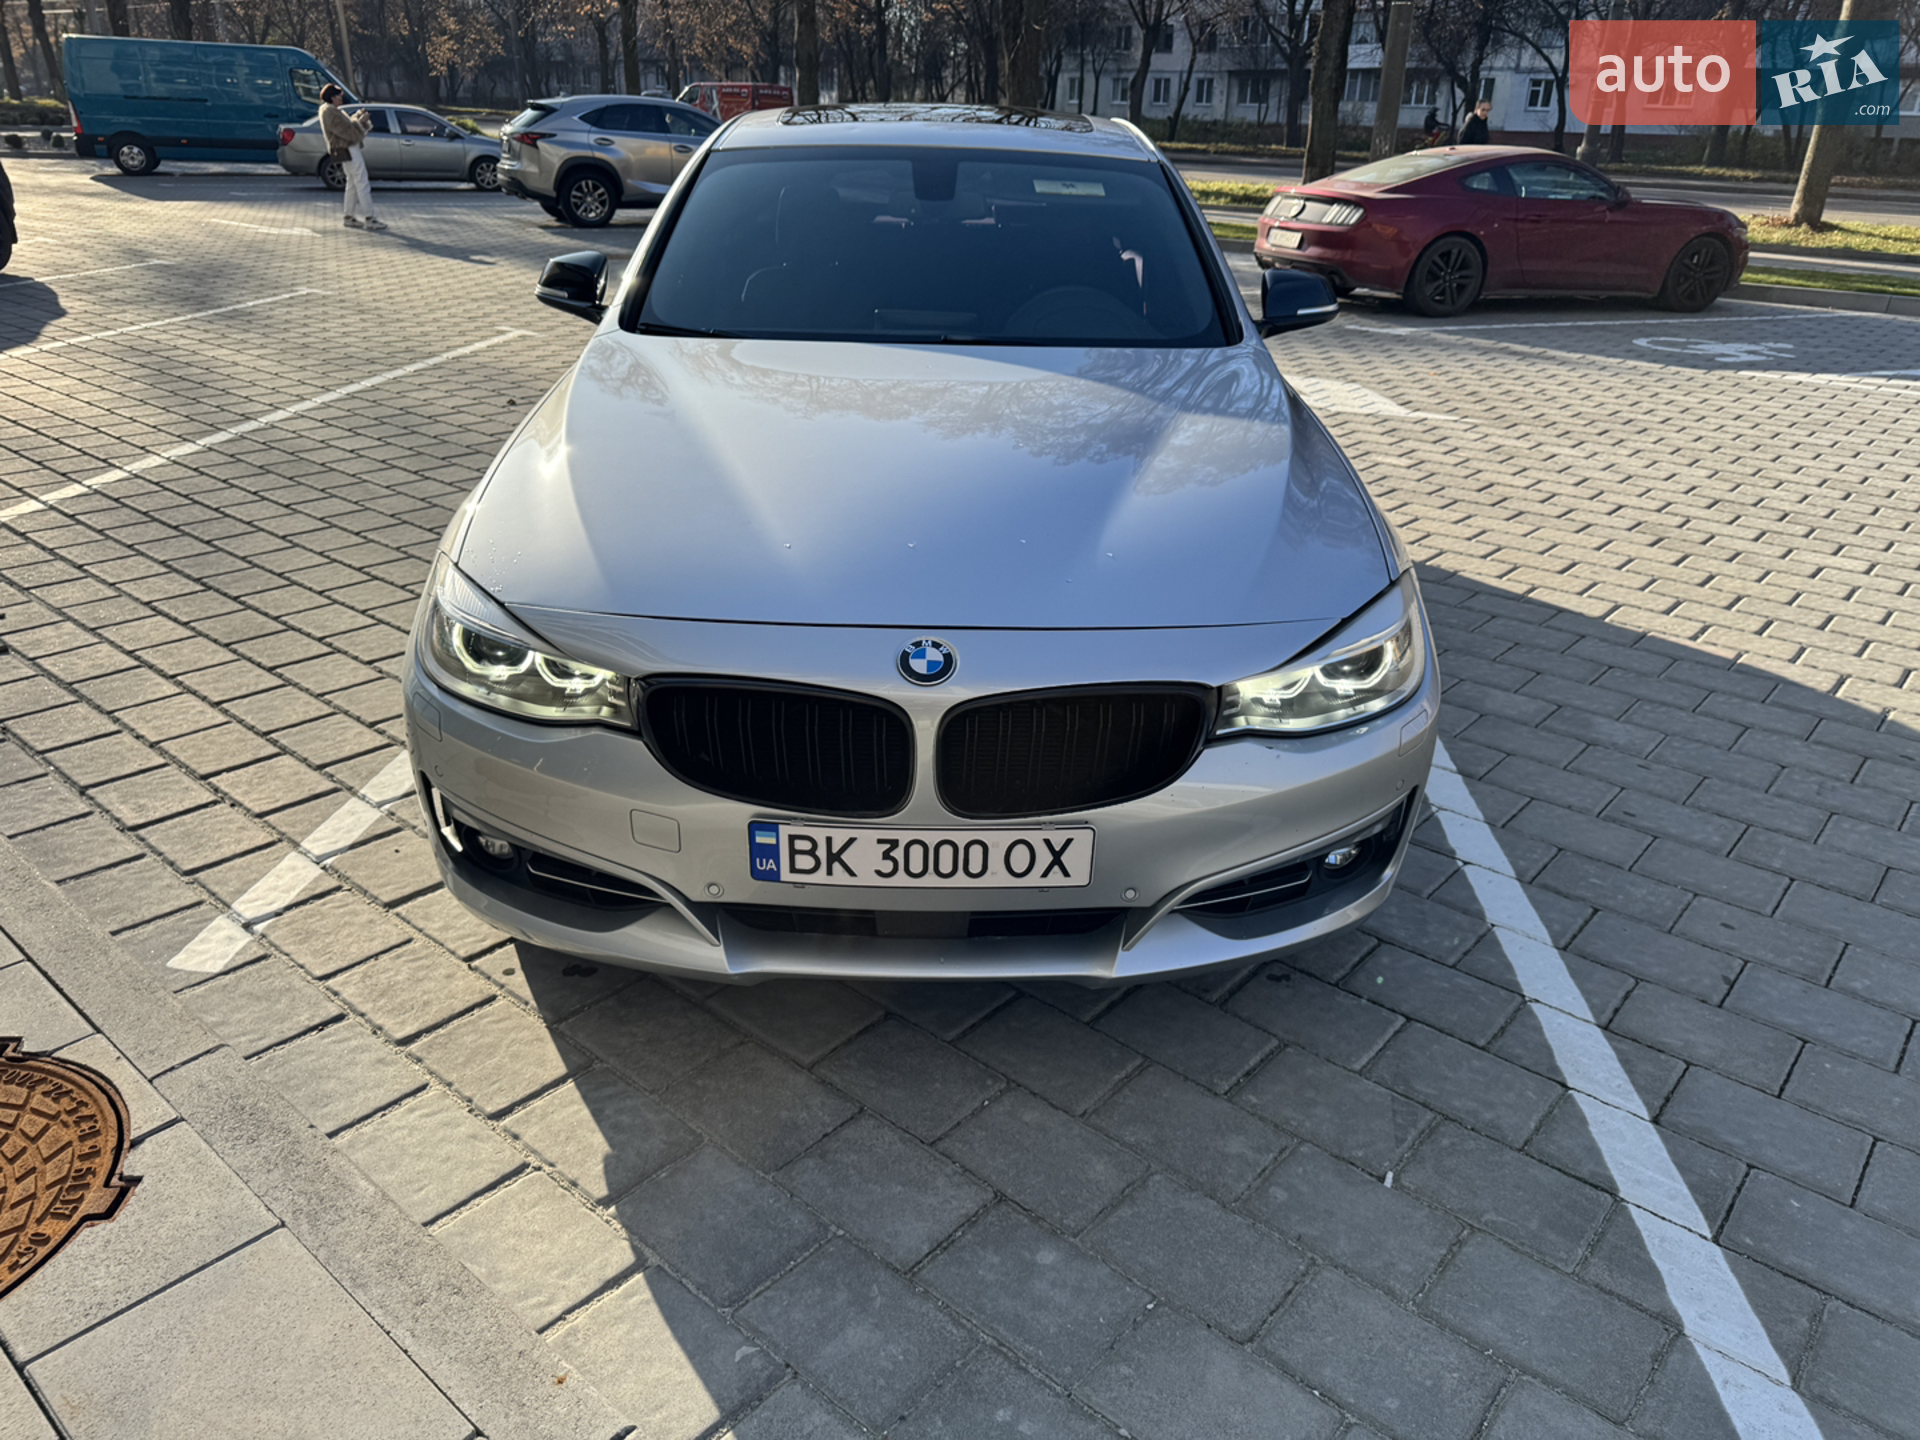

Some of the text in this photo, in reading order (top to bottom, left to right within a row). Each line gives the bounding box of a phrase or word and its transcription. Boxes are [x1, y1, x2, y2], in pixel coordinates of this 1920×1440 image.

[904, 640, 950, 654] BMW
[787, 833, 1075, 880] BK 3000 OX
[756, 858, 778, 872] UA
